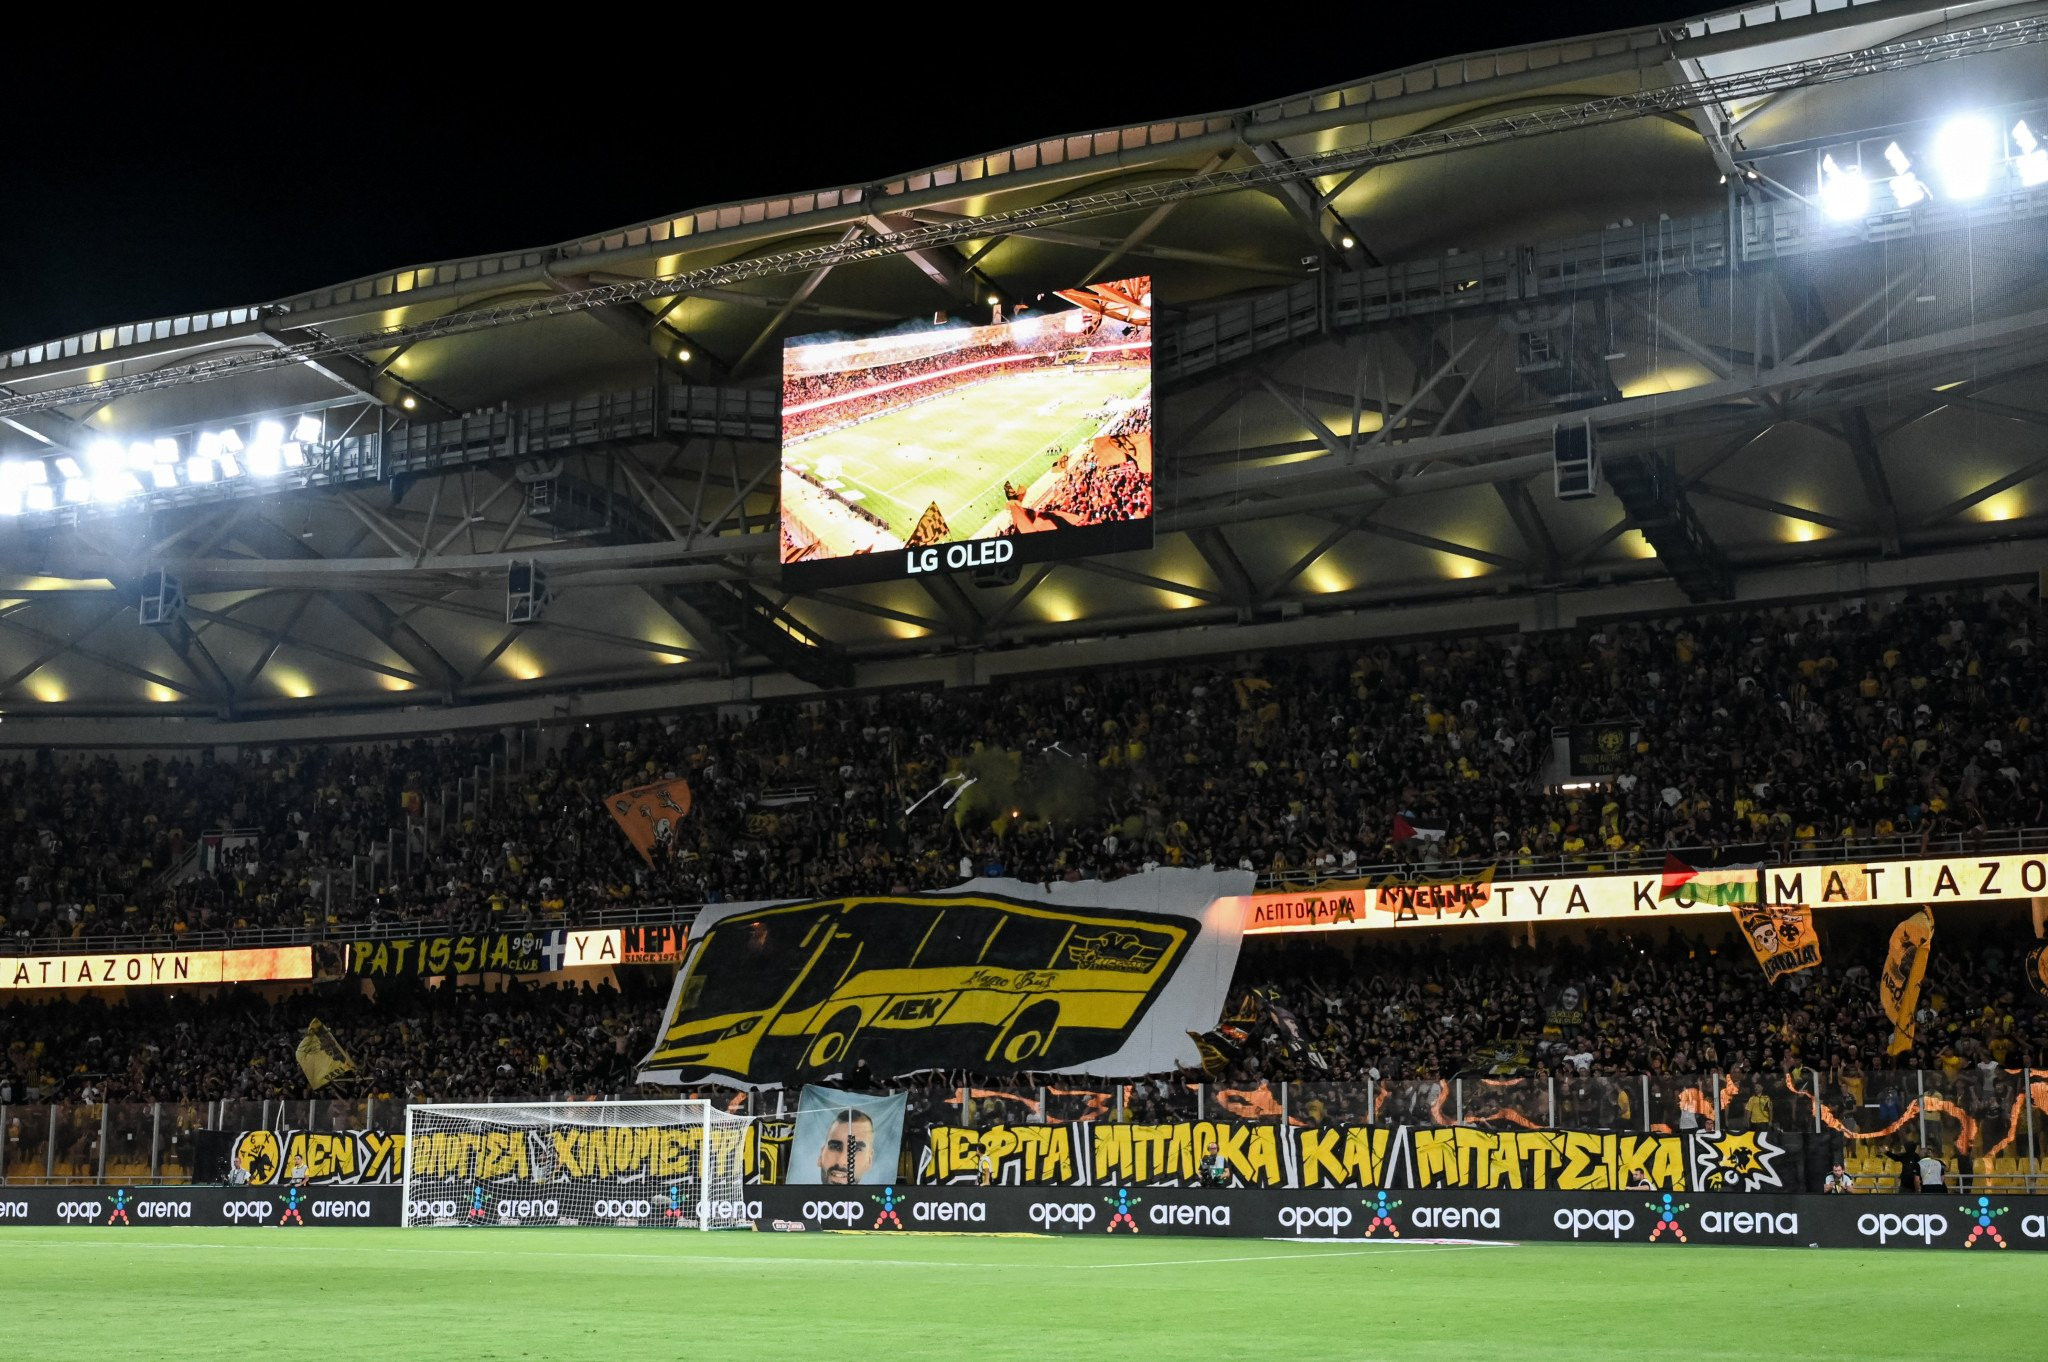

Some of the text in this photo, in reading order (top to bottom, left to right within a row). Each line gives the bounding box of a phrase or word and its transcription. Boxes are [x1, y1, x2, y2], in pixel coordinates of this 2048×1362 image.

[907, 539, 1014, 573] LG OLED
[354, 932, 509, 976] PATISSIA
[625, 953, 656, 963] SINCE
[882, 997, 943, 1021] AEK
[1300, 1126, 1390, 1187] ΚΑΙ
[57, 1202, 191, 1224] opap arena
[223, 1201, 370, 1224] opap arena
[802, 1201, 864, 1226] opap
[913, 1202, 986, 1221] arena
[1029, 1203, 1230, 1230] opap arena
[1278, 1206, 1500, 1234] opap arena
[1554, 1208, 1798, 1238] opap arena
[1858, 1213, 1948, 1244] opap
